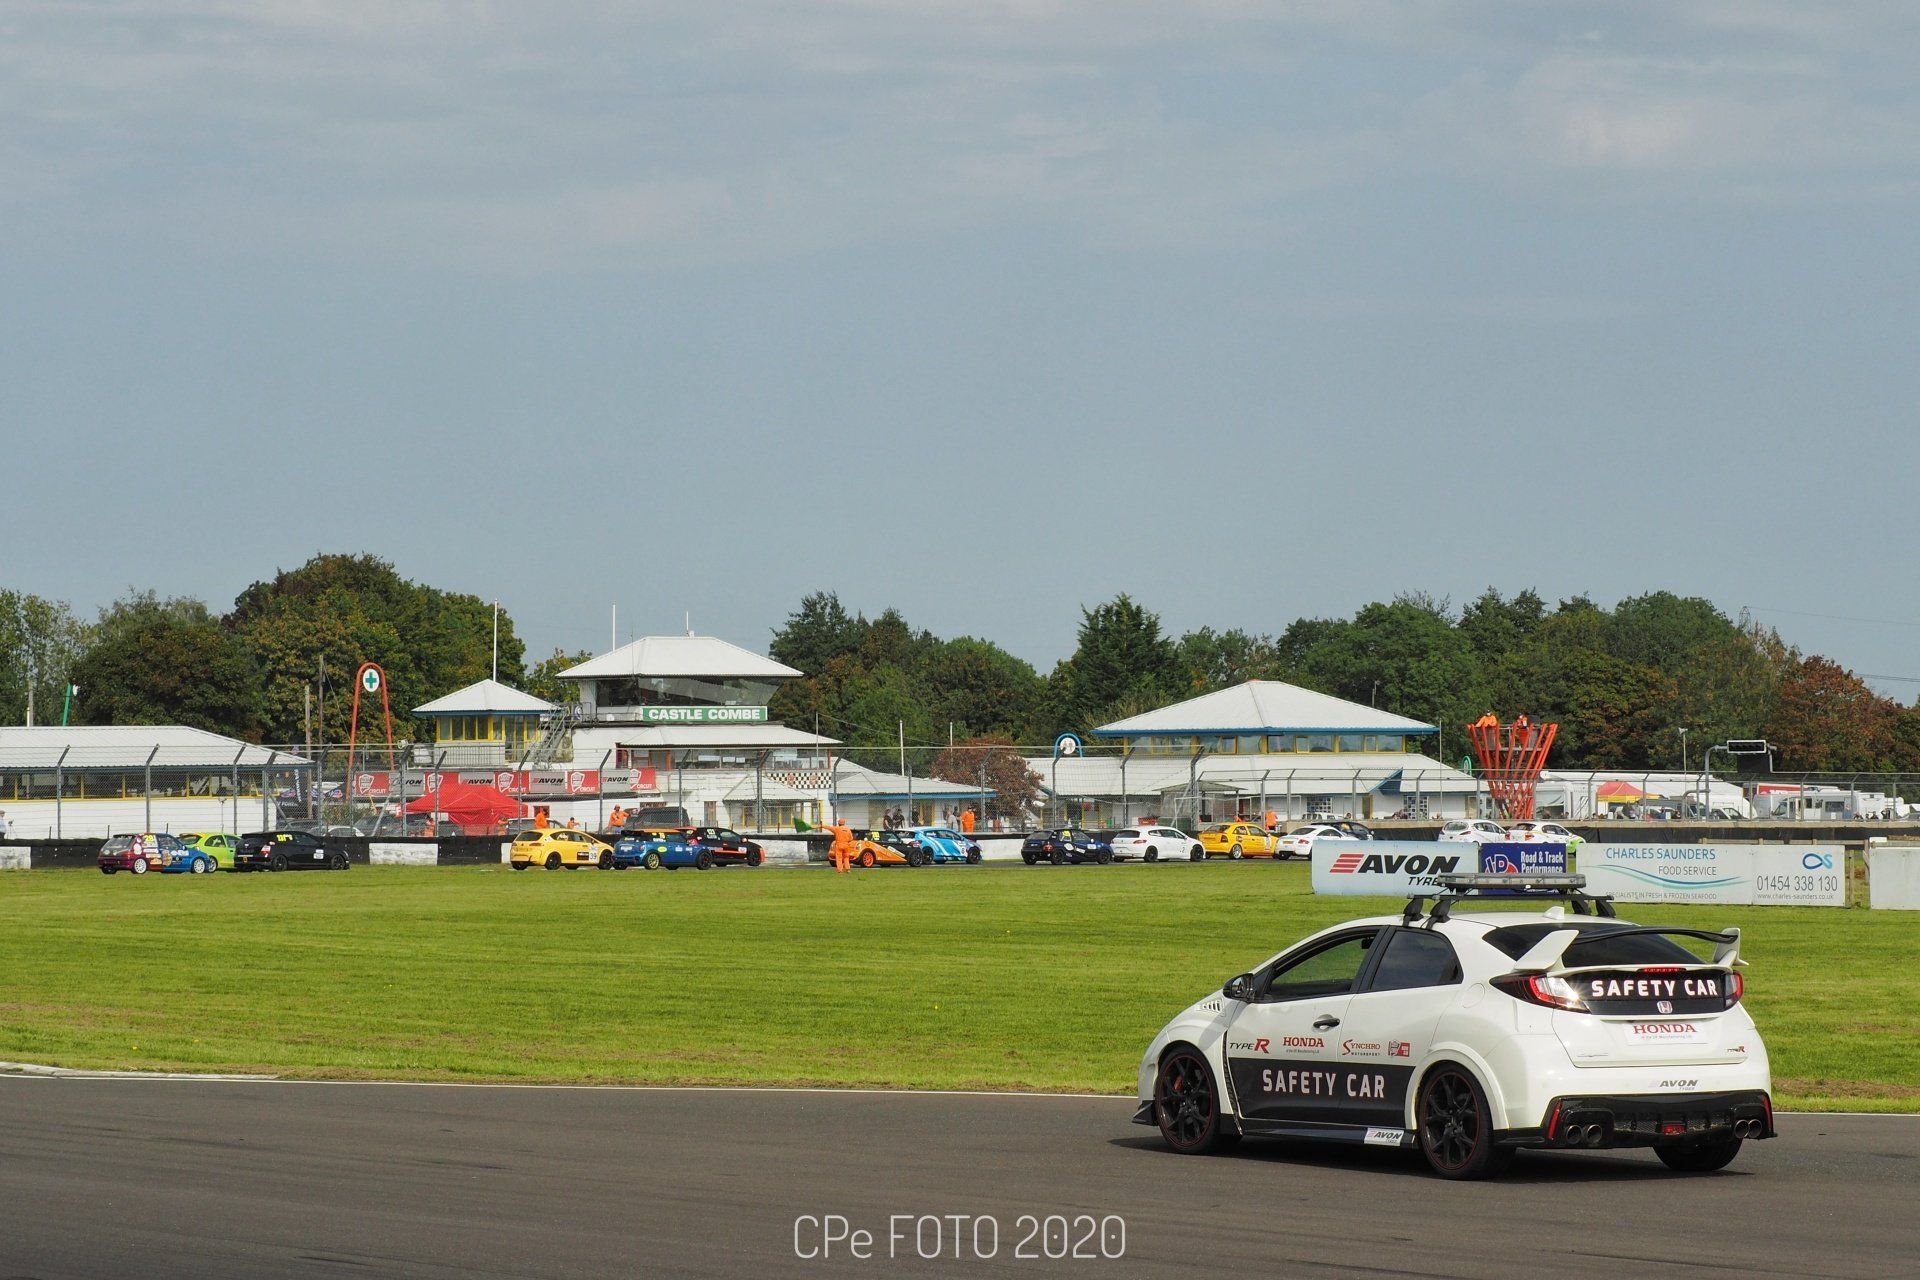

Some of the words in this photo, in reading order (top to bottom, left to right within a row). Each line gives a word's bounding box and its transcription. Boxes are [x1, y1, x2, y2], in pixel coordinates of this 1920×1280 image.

[648, 709, 703, 720] CASTLE
[707, 709, 760, 720] COMBE
[1521, 851, 1537, 864] Road
[1538, 852, 1543, 864] &
[1545, 851, 1564, 864] Track
[1606, 848, 1654, 859] CHARLES
[1657, 848, 1716, 860] SAUNDERS
[1357, 854, 1460, 875] AVON
[1521, 864, 1563, 874] Performance
[1658, 866, 1682, 875] FOOD
[1684, 866, 1717, 876] SERVICE
[1408, 876, 1439, 886] TYRE
[1756, 875, 1791, 892] 01454
[1794, 876, 1814, 892] 338
[1818, 876, 1838, 892] 130
[1591, 980, 1676, 997] SAFETY
[1684, 980, 1718, 996] CAR
[1633, 1024, 1698, 1034] HONDA
[1254, 1039, 1270, 1054] R
[1283, 1037, 1325, 1048] HONDA
[1342, 1039, 1381, 1056] SYNCHRO
[1263, 1069, 1336, 1096] SAFETY
[1346, 1073, 1385, 1098] CAR
[1374, 1131, 1402, 1140] AVON
